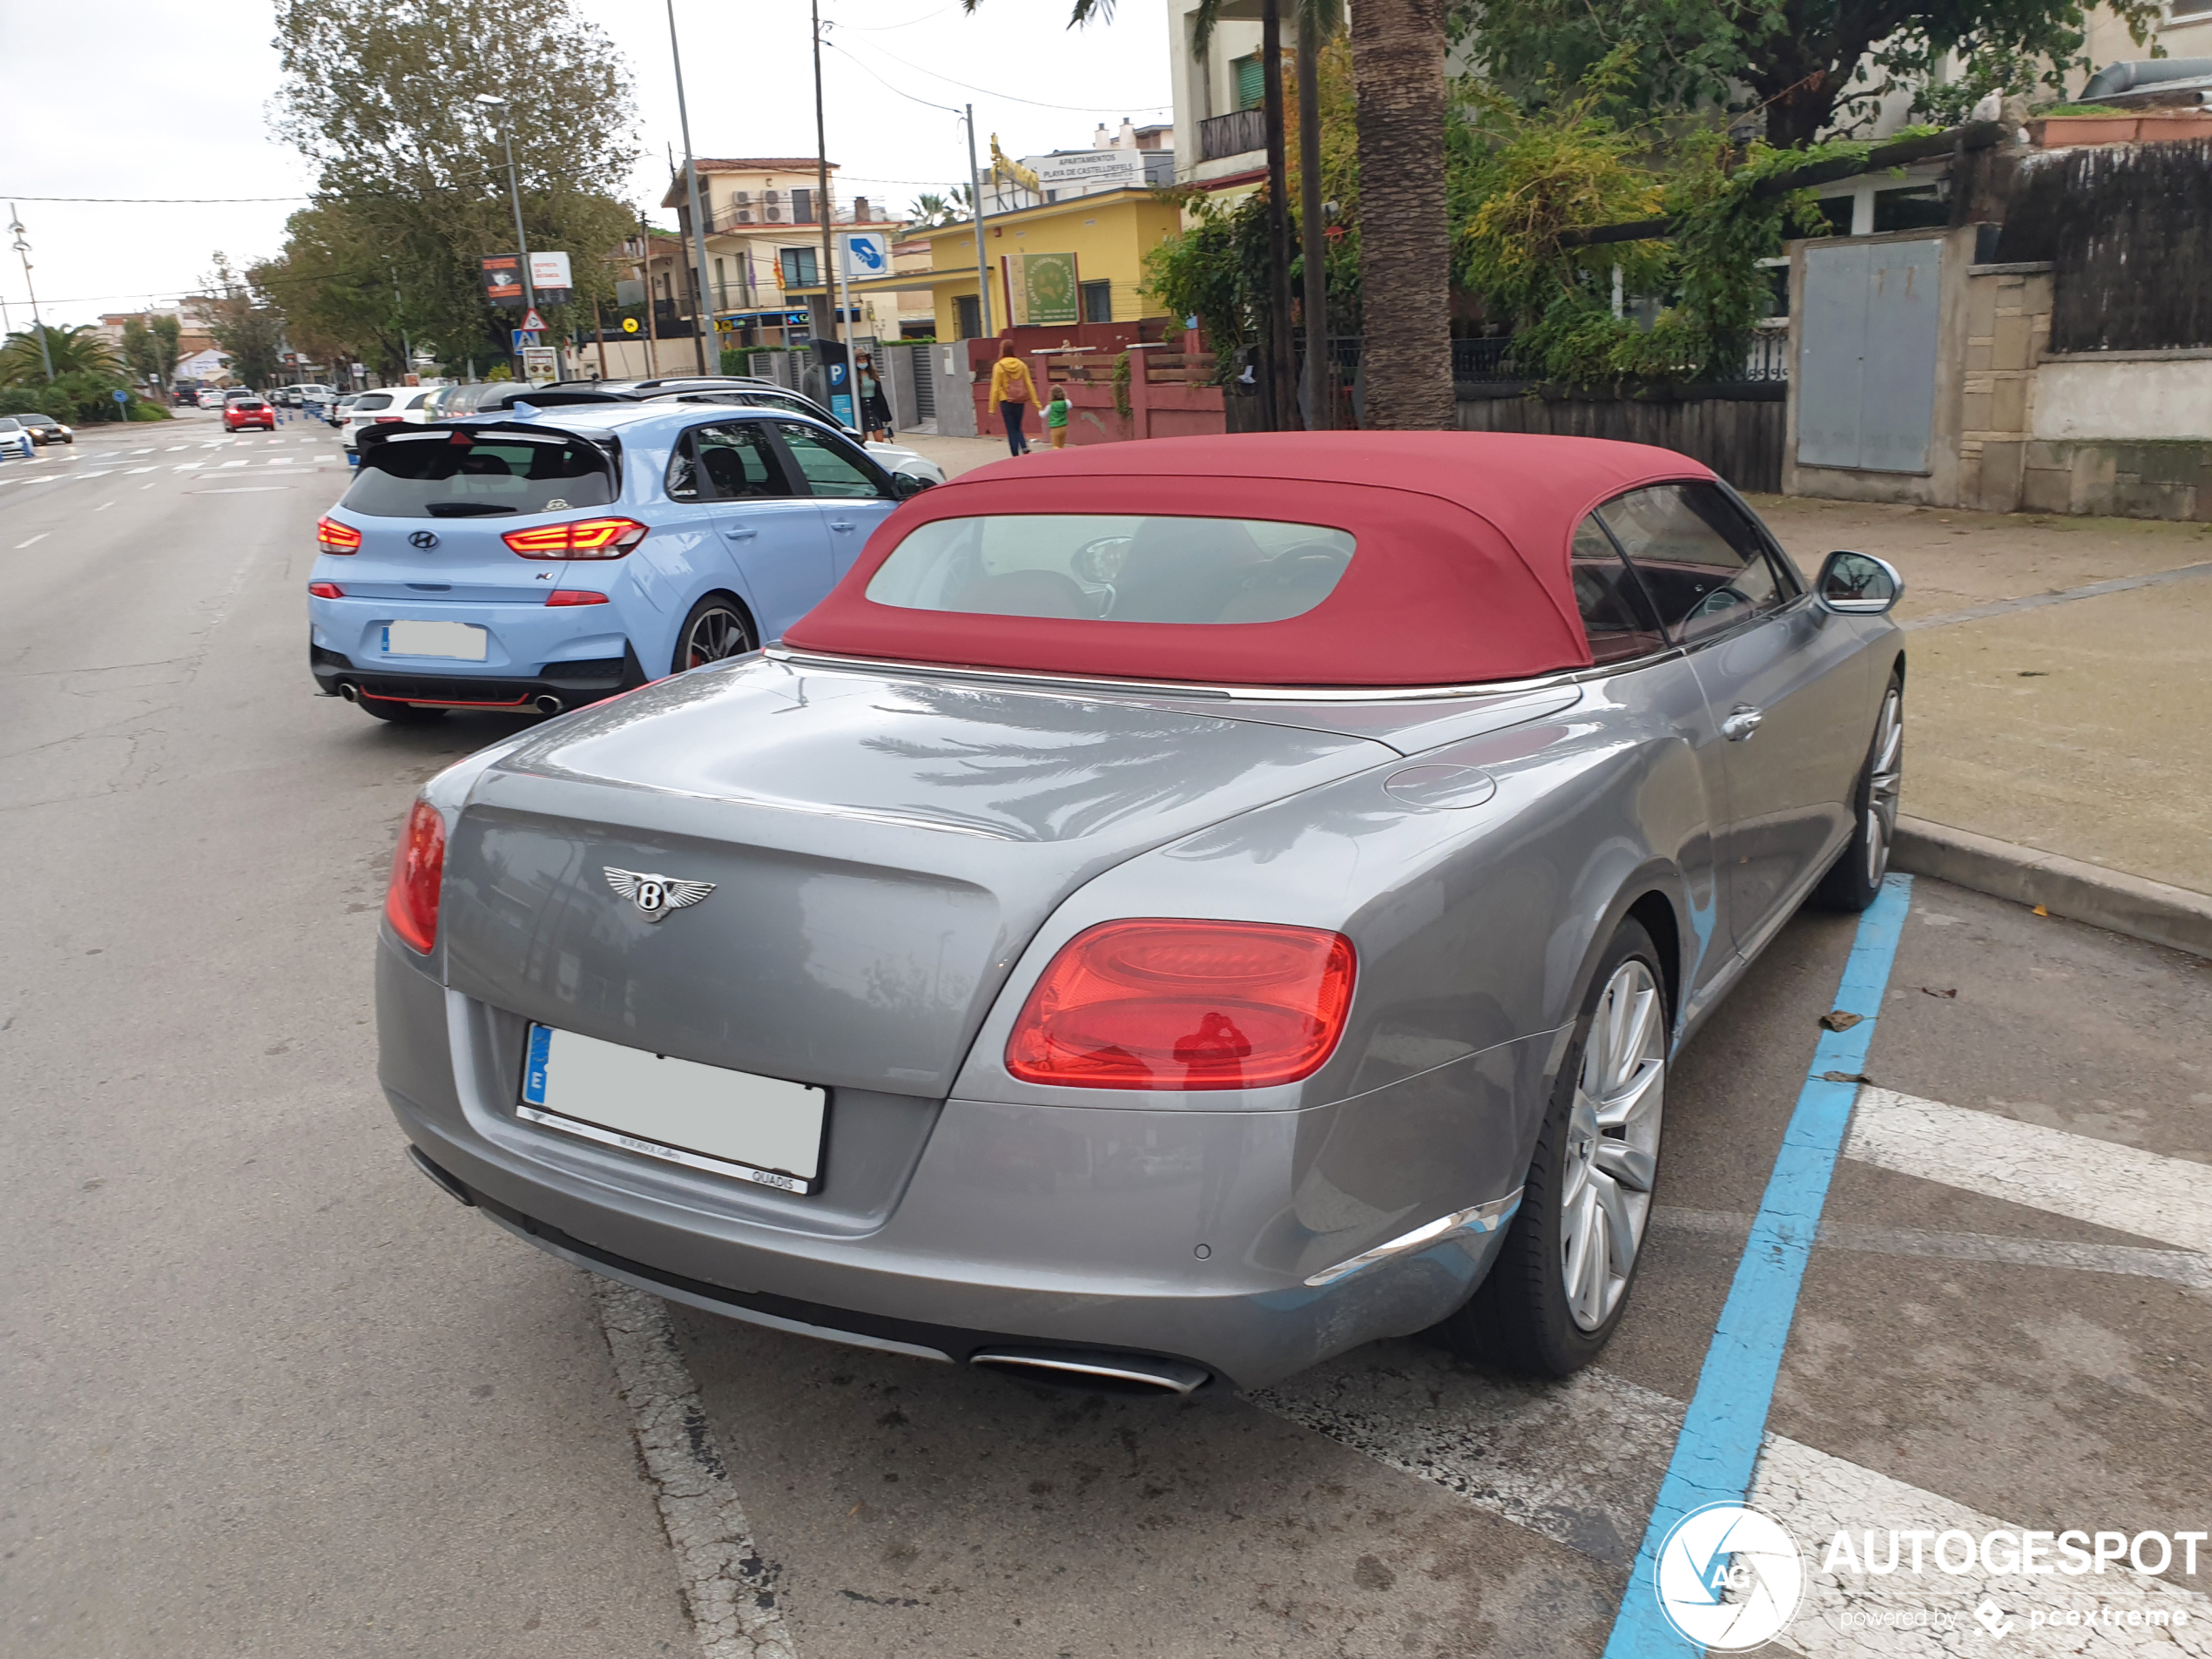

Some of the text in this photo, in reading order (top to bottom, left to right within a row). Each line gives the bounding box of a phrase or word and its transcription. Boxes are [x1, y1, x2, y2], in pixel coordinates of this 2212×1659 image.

[1058, 154, 1116, 165] APARTAMENTOS
[1076, 163, 1133, 174] CASTELLDEFELS
[830, 365, 842, 381] P
[638, 883, 662, 909] B
[530, 1071, 543, 1089] E
[752, 1170, 794, 1190] QUADIS
